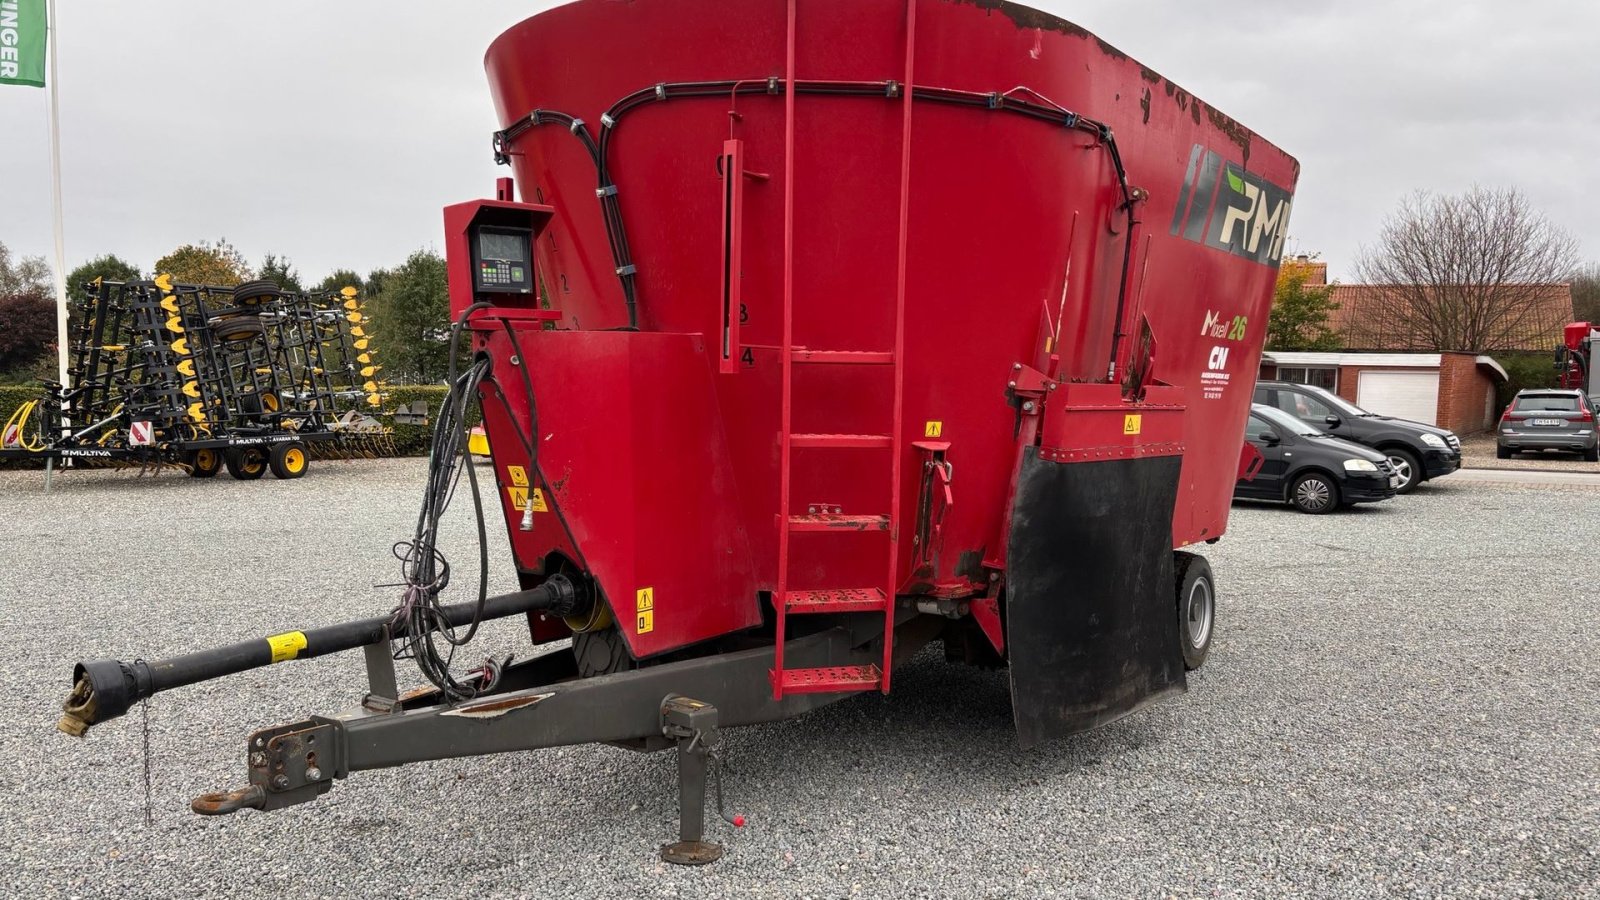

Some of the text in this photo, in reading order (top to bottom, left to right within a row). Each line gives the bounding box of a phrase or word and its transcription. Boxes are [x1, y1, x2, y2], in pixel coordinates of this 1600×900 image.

[0, 0, 19, 79] INGER
[1228, 316, 1247, 341] 26
[741, 346, 755, 366] 4
[1208, 346, 1229, 369] CN
